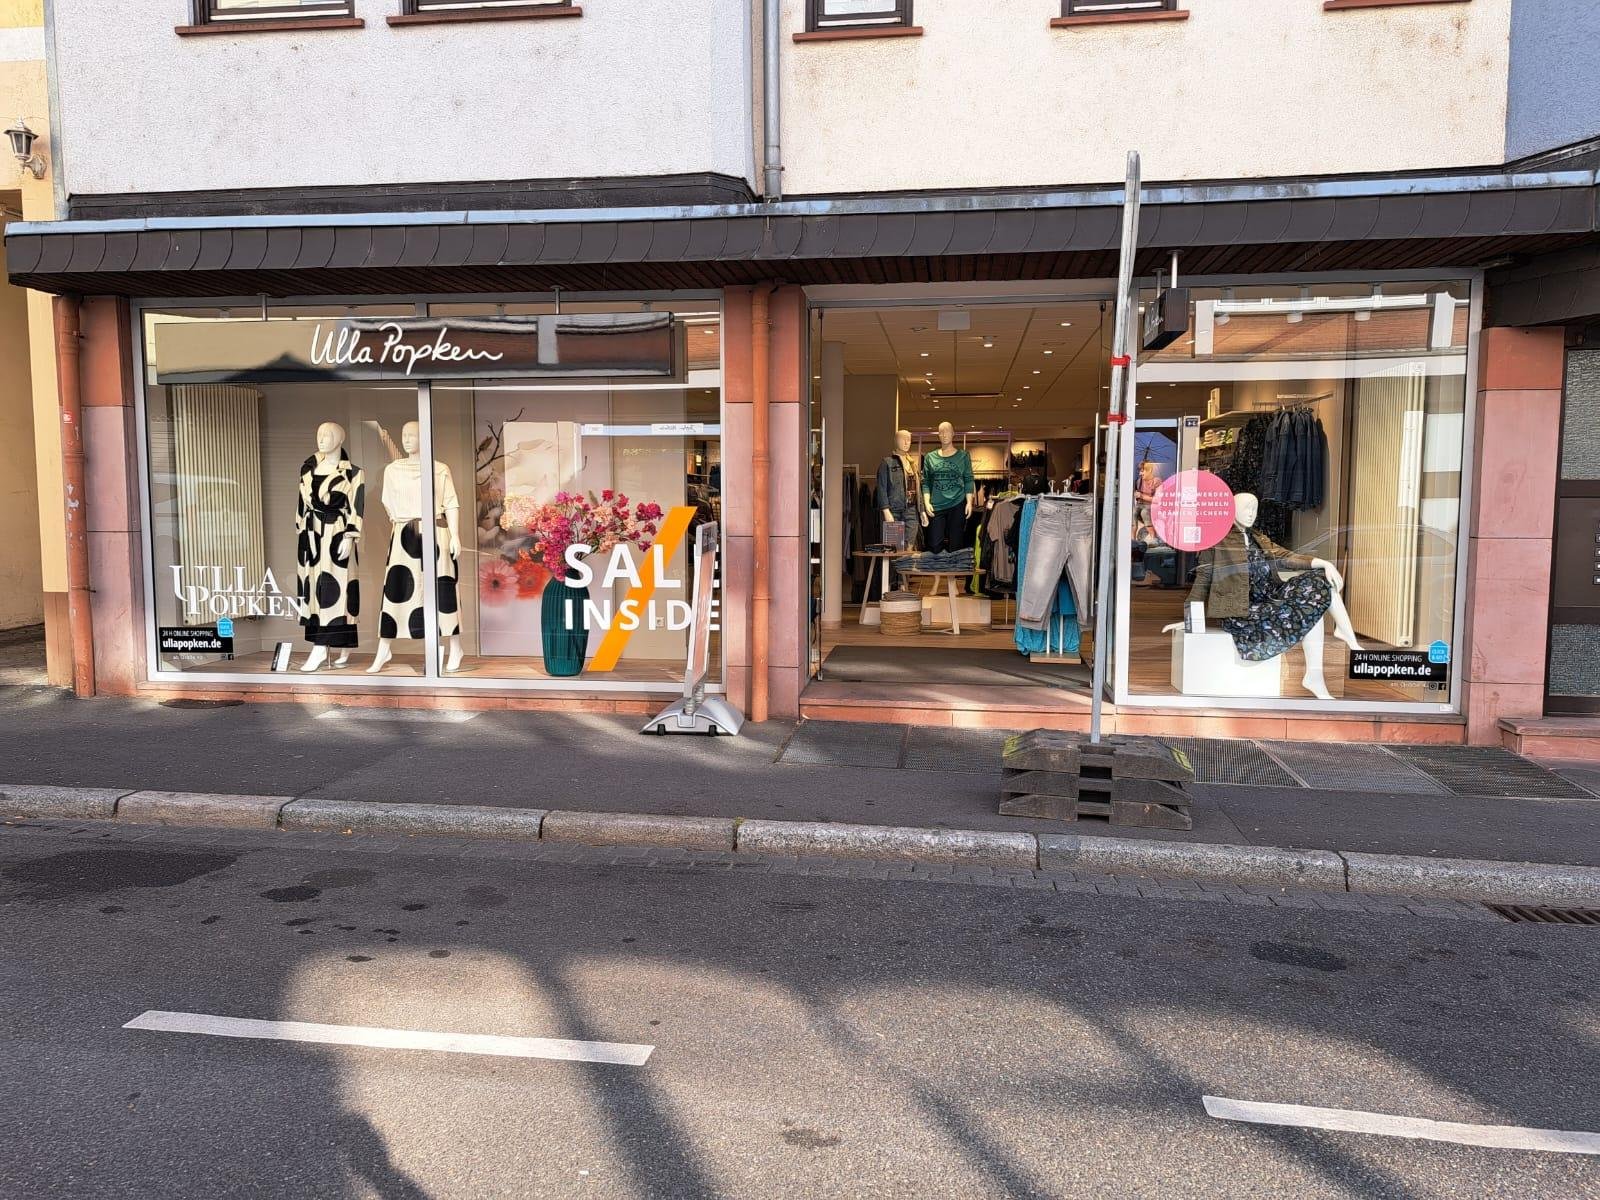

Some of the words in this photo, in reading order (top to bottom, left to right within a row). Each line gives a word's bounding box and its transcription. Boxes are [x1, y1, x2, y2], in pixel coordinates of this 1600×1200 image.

[310, 323, 373, 365] Ulla
[378, 322, 503, 376] Popken
[169, 565, 282, 602] ULLA
[185, 585, 305, 617] POPKEN
[162, 638, 222, 651] ullapopken.de
[1353, 662, 1432, 678] ullapopken.de
[1369, 654, 1390, 662] ONLINE
[1392, 655, 1422, 663] SHOPPING
